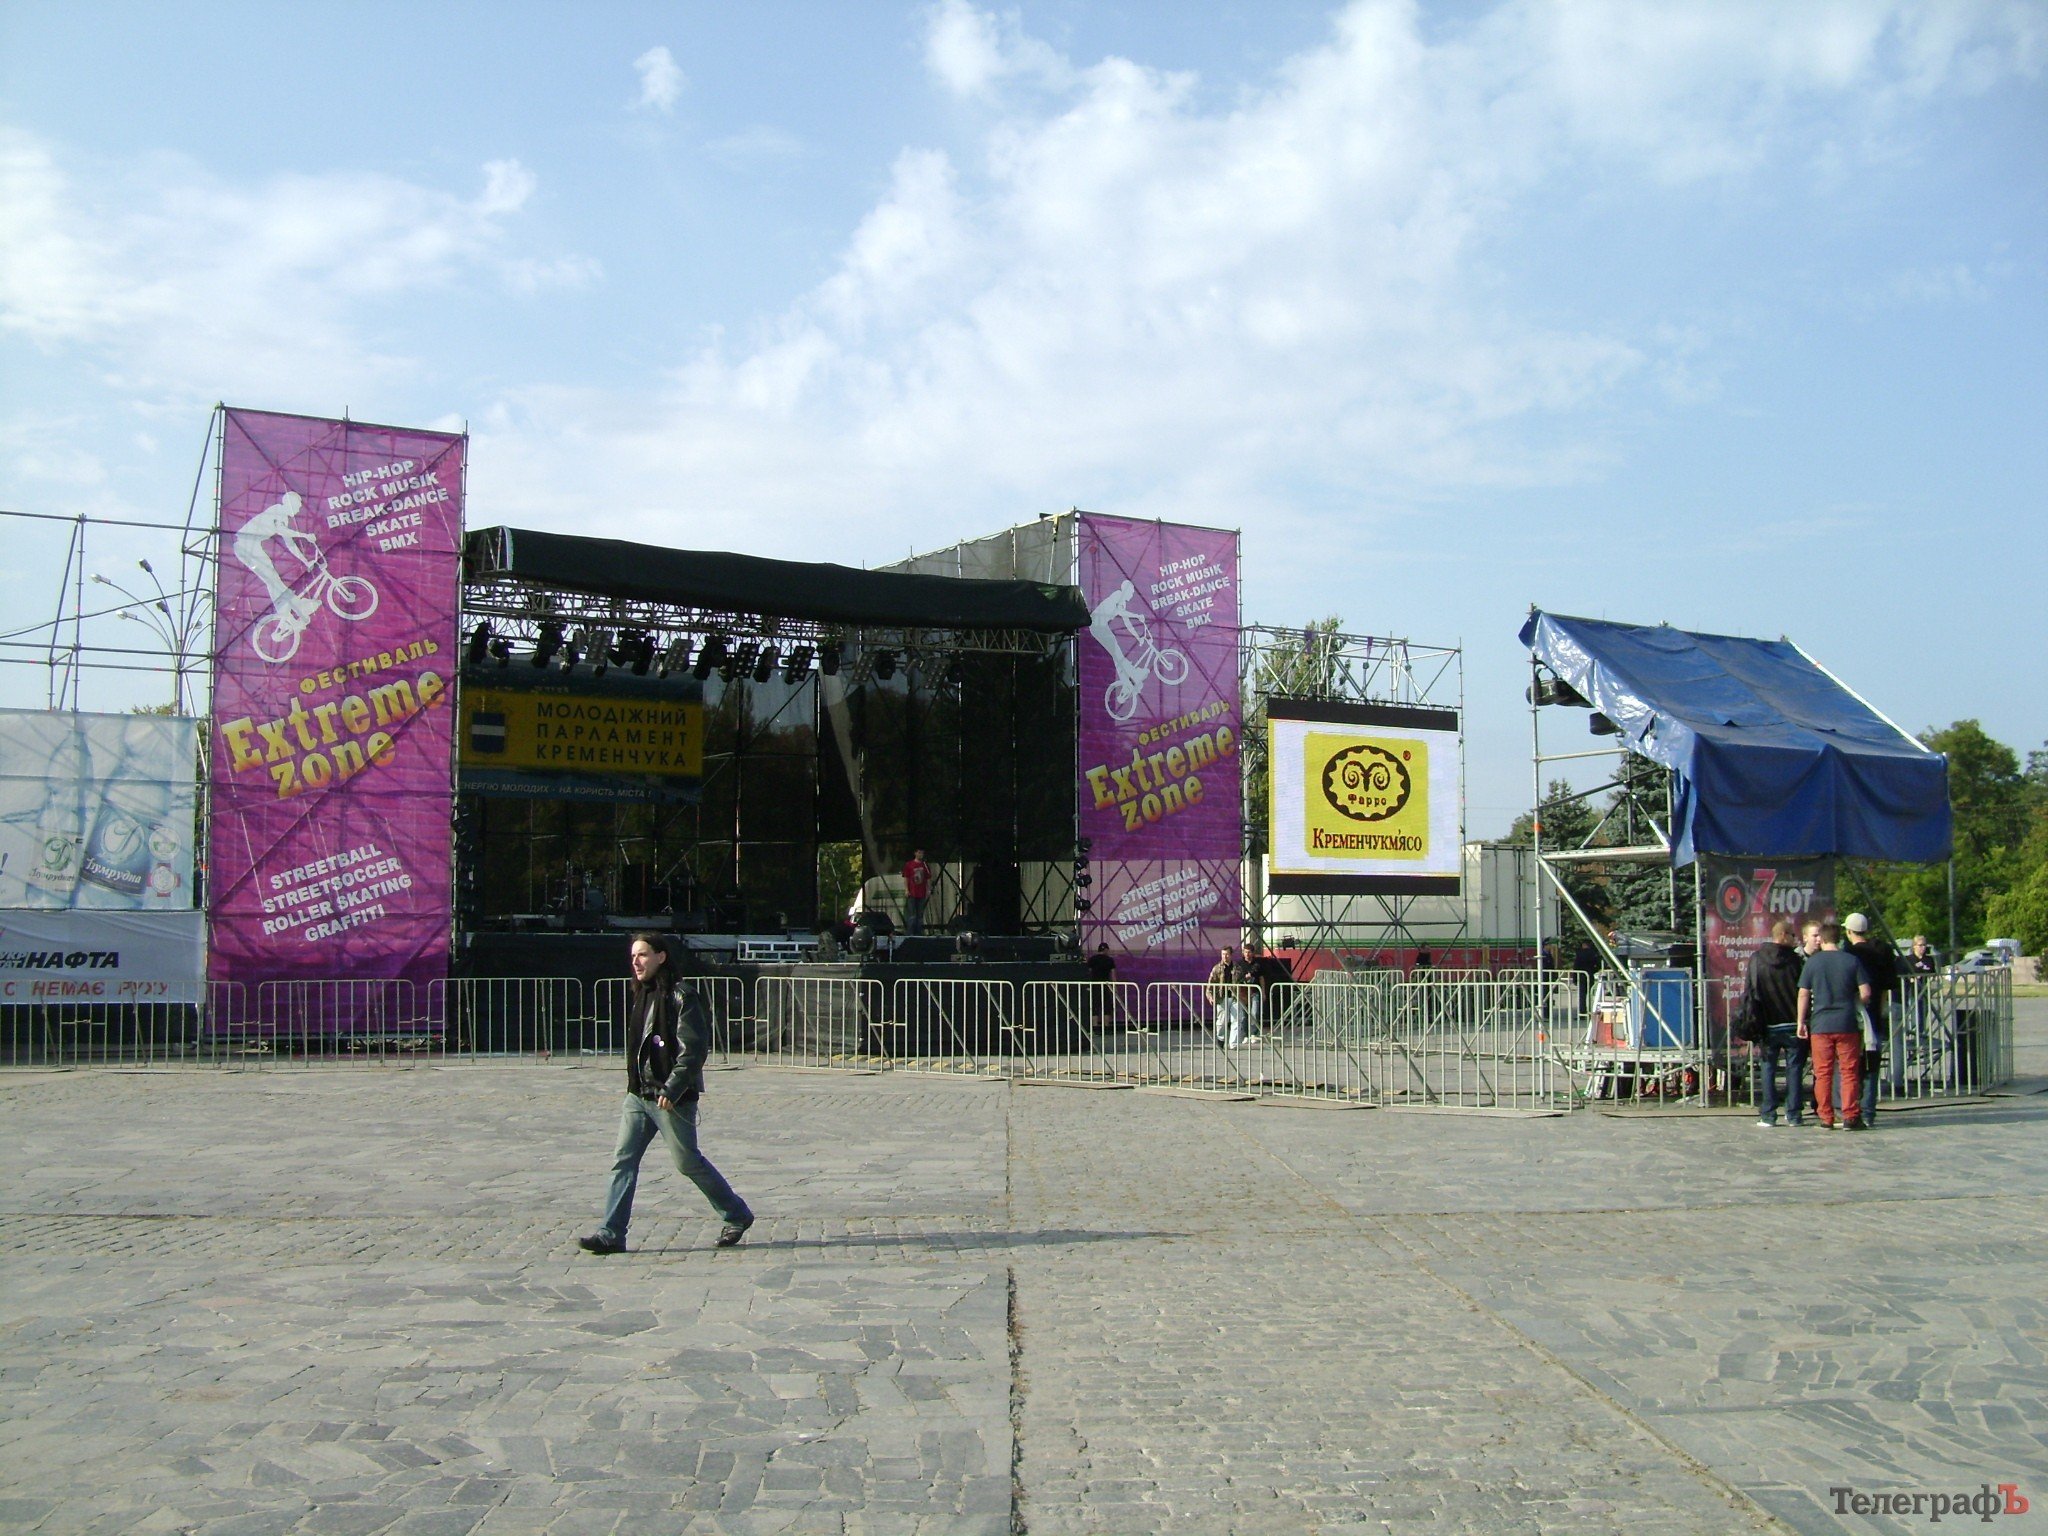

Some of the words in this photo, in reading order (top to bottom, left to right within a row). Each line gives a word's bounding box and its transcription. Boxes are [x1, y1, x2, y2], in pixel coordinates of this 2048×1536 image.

[327, 487, 379, 510] ROCK
[382, 472, 439, 498] MUSIK
[342, 460, 414, 487] HIP-HOP
[326, 488, 449, 529] BREAK-DANCE
[366, 512, 422, 537] SKATE
[379, 532, 419, 552] BMX
[1151, 576, 1184, 595] ROCK
[1186, 564, 1223, 584] MUSIK
[1159, 554, 1206, 577] HIP-HOP
[1151, 577, 1231, 611] BREAK-DANCE
[1176, 597, 1214, 617] SKATE
[1186, 612, 1212, 629] BMX
[300, 639, 439, 694] ФЕСТИВАЛЬ
[221, 671, 445, 774] Extreme
[537, 702, 687, 726] МОЛОДІЖНИЙ
[1138, 700, 1230, 746] ФЕСТИВАЛЬ
[537, 725, 688, 746] ПАРЛАМЕНТ
[270, 731, 395, 800] zone
[537, 744, 687, 767] КРЕМЕНЧУКА
[1085, 725, 1235, 811] Extreme
[502, 783, 550, 794] МОЛОДИХ
[559, 786, 571, 794] НА
[1120, 775, 1203, 833] zone
[271, 843, 381, 889] STREETBALL
[263, 856, 400, 914] STREETSOCCER
[1117, 878, 1210, 924] STREETSOCCER
[1121, 867, 1198, 906] STREETBALL
[263, 901, 334, 936] ROLLER
[336, 874, 412, 911] SKATING
[305, 903, 385, 942] GRAFFITI
[1118, 914, 1165, 942] ROLLER
[1166, 891, 1218, 925] SKATING
[1147, 916, 1199, 947] GRAFFITI
[26, 951, 119, 968] НАФТА
[32, 980, 105, 996] НЕМАЄ
[118, 981, 169, 996] РУХУ
